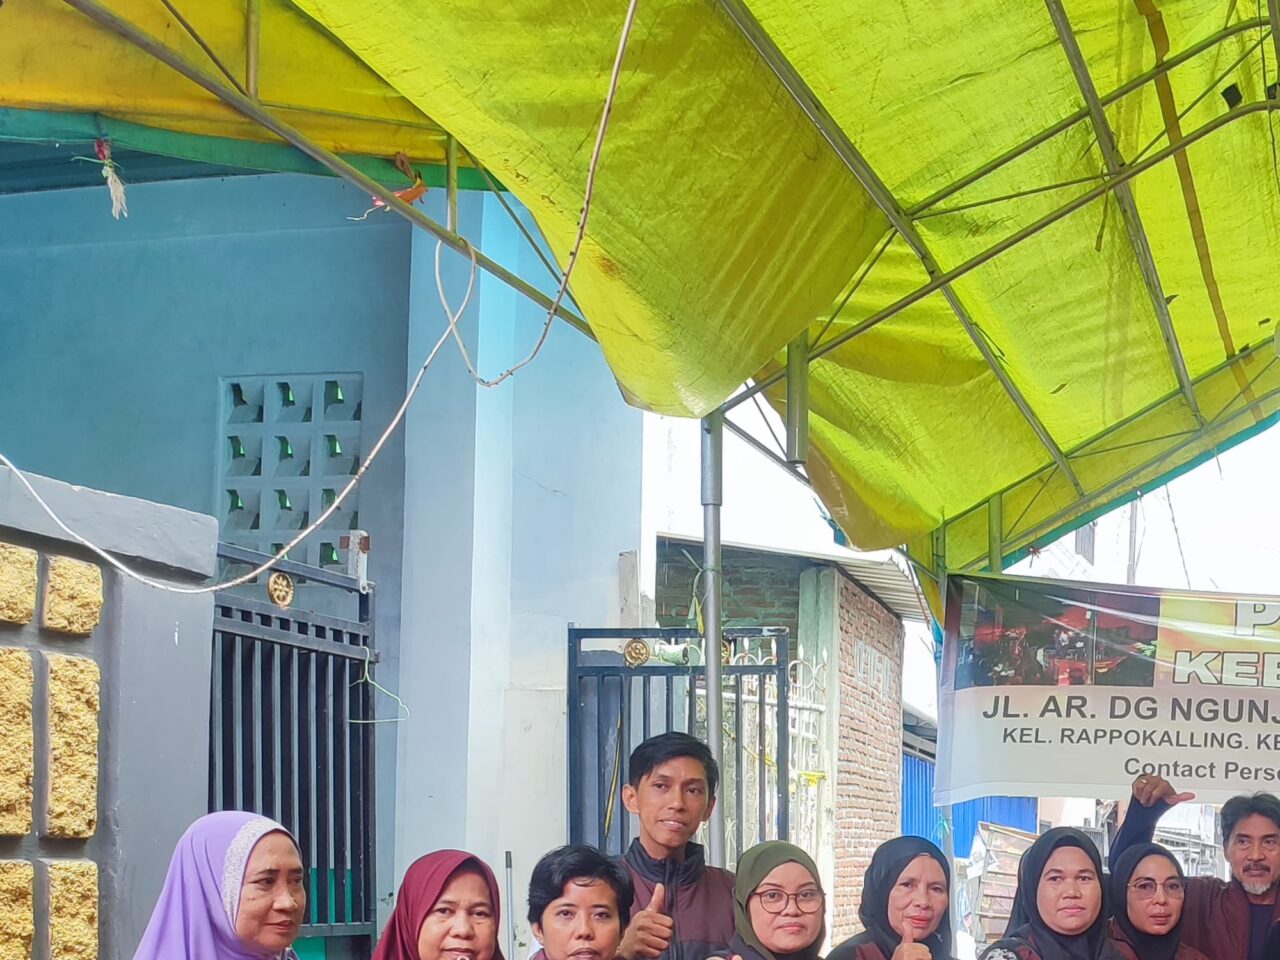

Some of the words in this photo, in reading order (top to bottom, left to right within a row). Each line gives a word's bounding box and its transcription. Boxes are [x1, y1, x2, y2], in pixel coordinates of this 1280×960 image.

[983, 695, 1029, 719] JL.
[1039, 695, 1096, 720] AR.
[1109, 695, 1158, 722] DG
[1002, 727, 1053, 744] KEL.
[1060, 728, 1249, 750] RAPPOKALLING.
[1124, 757, 1216, 779] Contact
